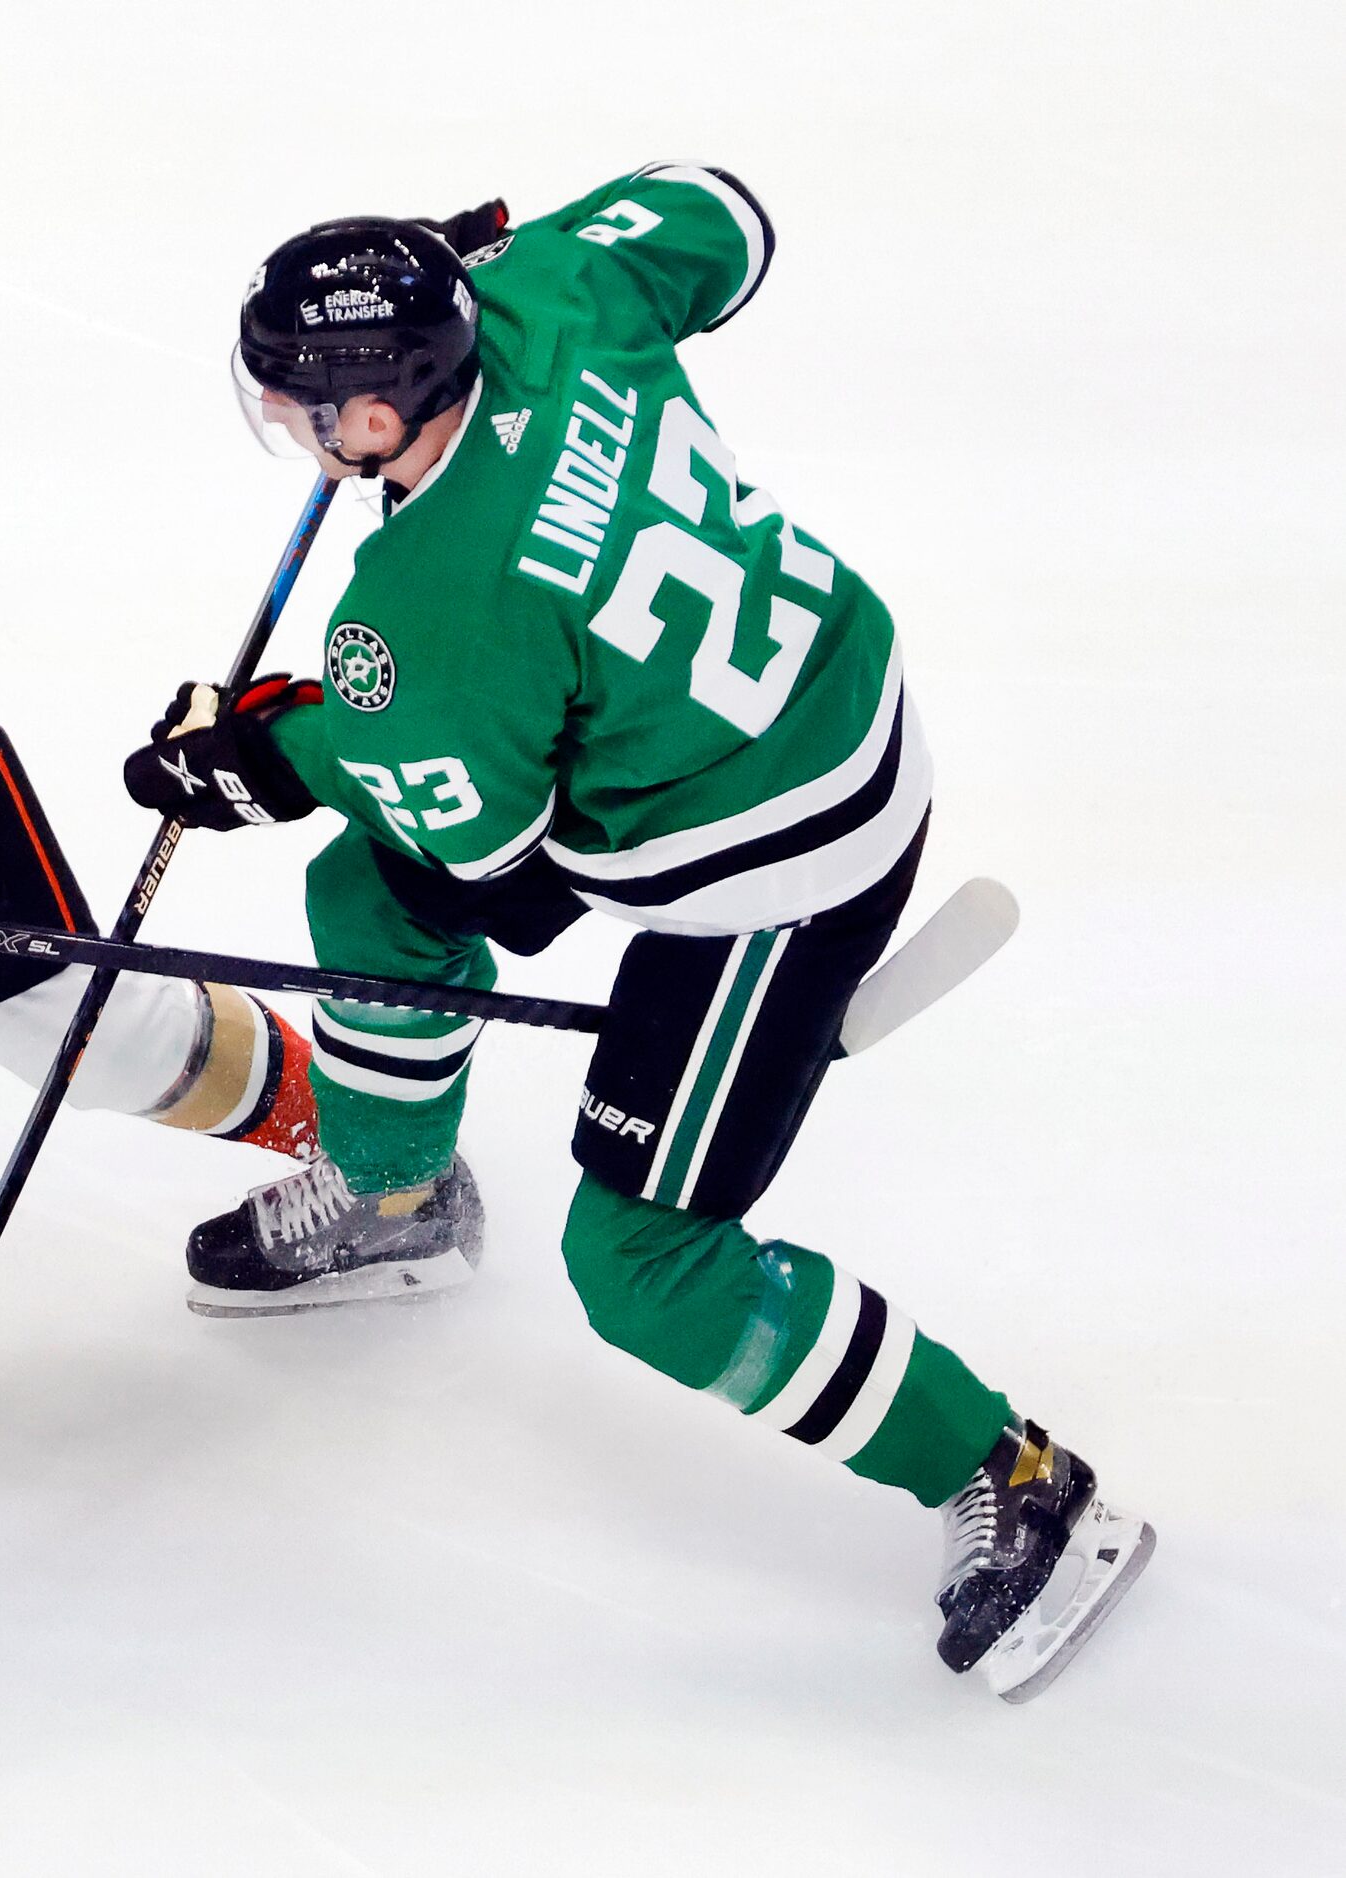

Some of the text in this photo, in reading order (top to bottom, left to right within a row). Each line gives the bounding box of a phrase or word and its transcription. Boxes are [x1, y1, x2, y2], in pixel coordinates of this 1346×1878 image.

[325, 290, 381, 309] ENERGY
[326, 303, 394, 322] TRANSFER
[506, 407, 532, 455] adidas
[517, 369, 637, 595] LINDELL
[332, 628, 388, 665] DALLAS
[336, 676, 390, 707] STARS
[135, 819, 182, 916] BAUER
[27, 940, 60, 956] SL
